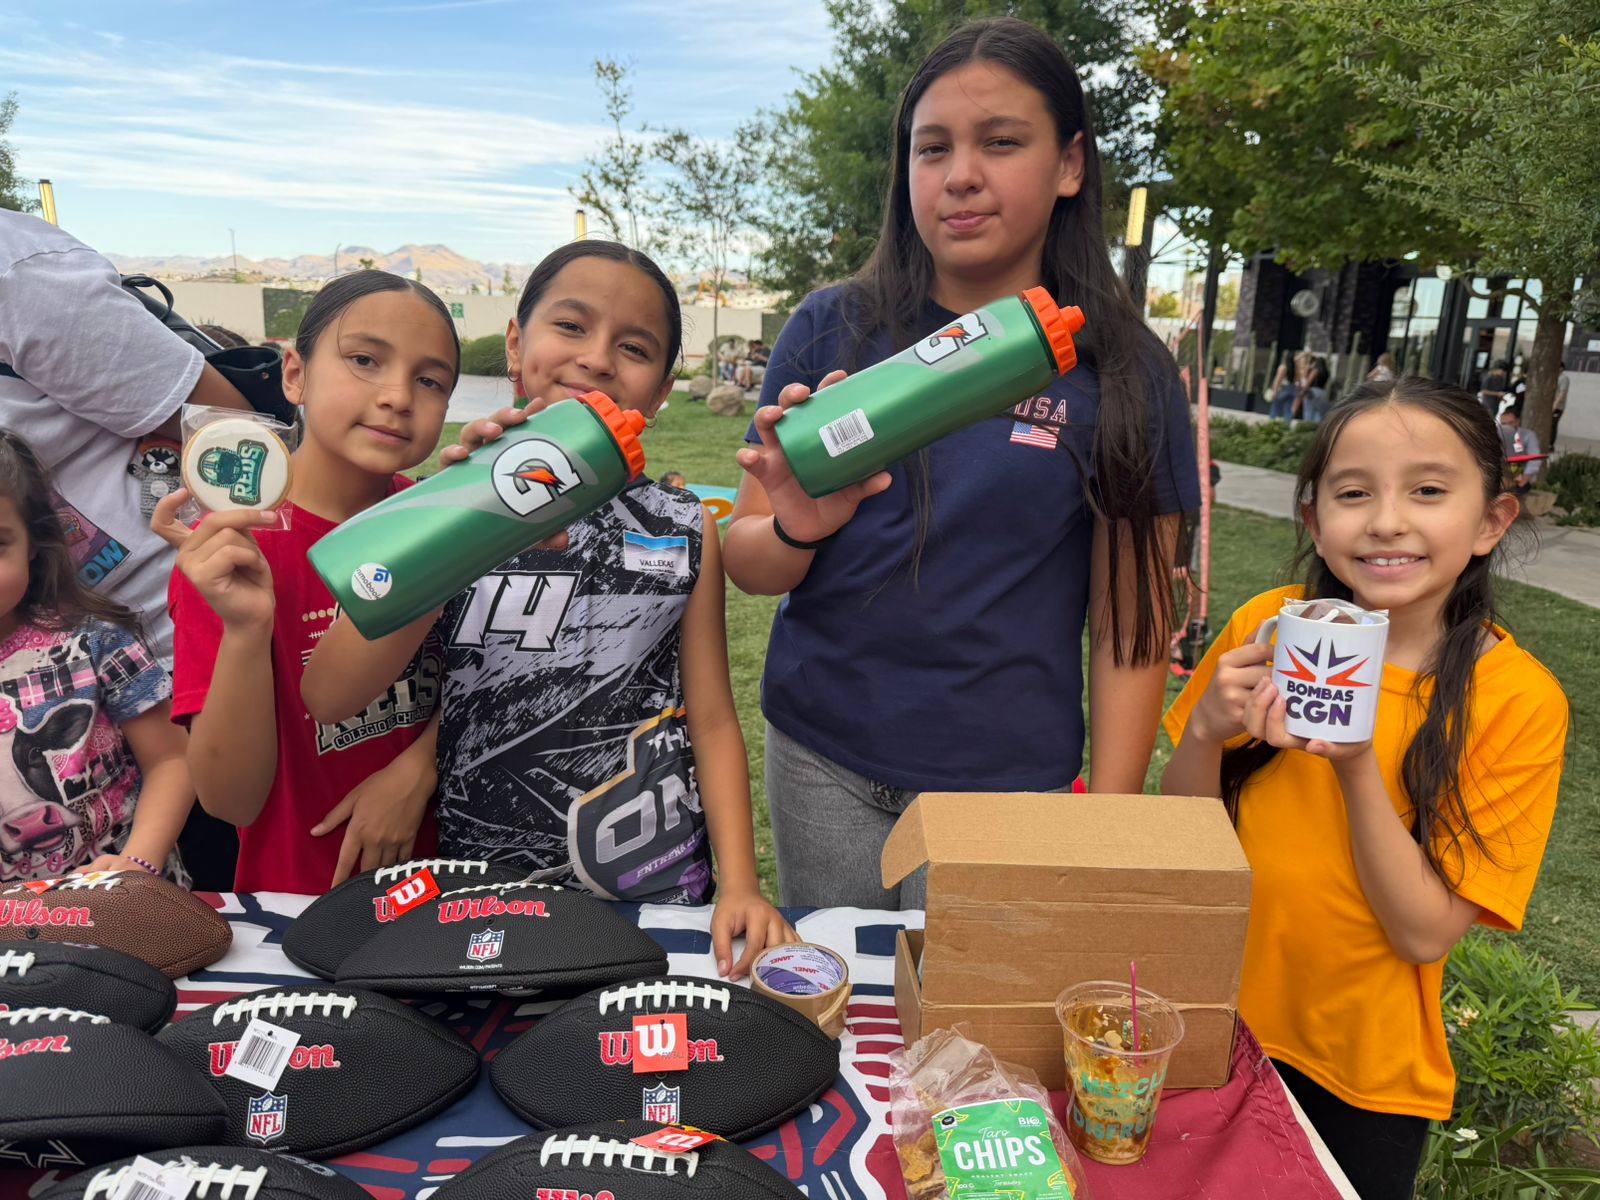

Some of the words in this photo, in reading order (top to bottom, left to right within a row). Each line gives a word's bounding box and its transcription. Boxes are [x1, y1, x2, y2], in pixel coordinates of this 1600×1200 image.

[1013, 396, 1067, 424] USA
[234, 445, 261, 501] REDS
[639, 559, 675, 569] VALLEKAS
[448, 571, 582, 653] 14
[1286, 680, 1355, 703] BOMBAS
[1285, 695, 1352, 727] CGN
[335, 720, 387, 748] COLEGIO
[438, 895, 546, 924] Wilson
[471, 943, 497, 958] NFL
[251, 1112, 281, 1136] NFL
[647, 1104, 676, 1124] NFL
[978, 1126, 1009, 1141] Taro
[953, 1135, 1046, 1171] CHIPS
